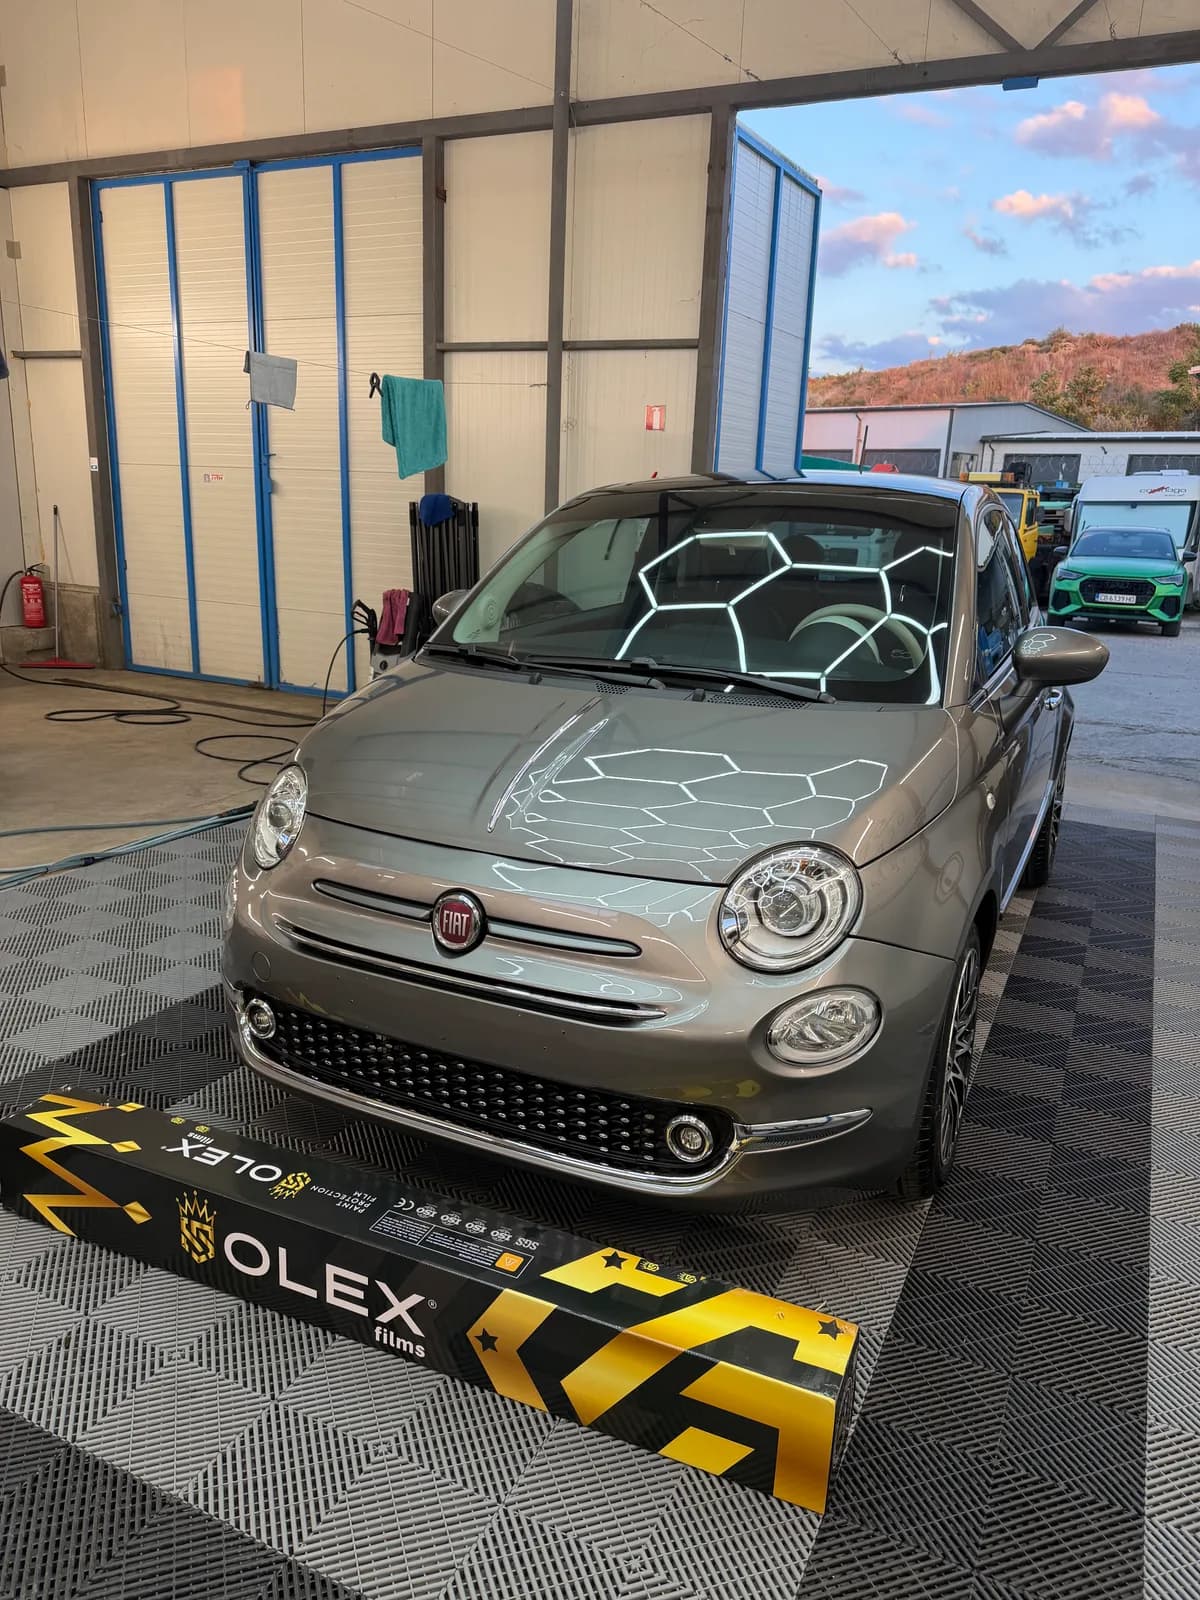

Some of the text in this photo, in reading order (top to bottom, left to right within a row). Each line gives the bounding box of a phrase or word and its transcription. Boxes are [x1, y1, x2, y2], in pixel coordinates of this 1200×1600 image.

[442, 910, 470, 937] FIAT
[186, 1132, 215, 1145] films
[310, 1185, 372, 1208] PROTECTION
[352, 1191, 377, 1203] FILM
[335, 1201, 366, 1214] PAINT
[415, 1206, 439, 1218] ISO
[440, 1213, 462, 1226] ISO
[464, 1222, 488, 1234] ISO
[489, 1230, 513, 1242] ISO
[514, 1237, 540, 1251] SGS
[374, 1326, 426, 1358] films
